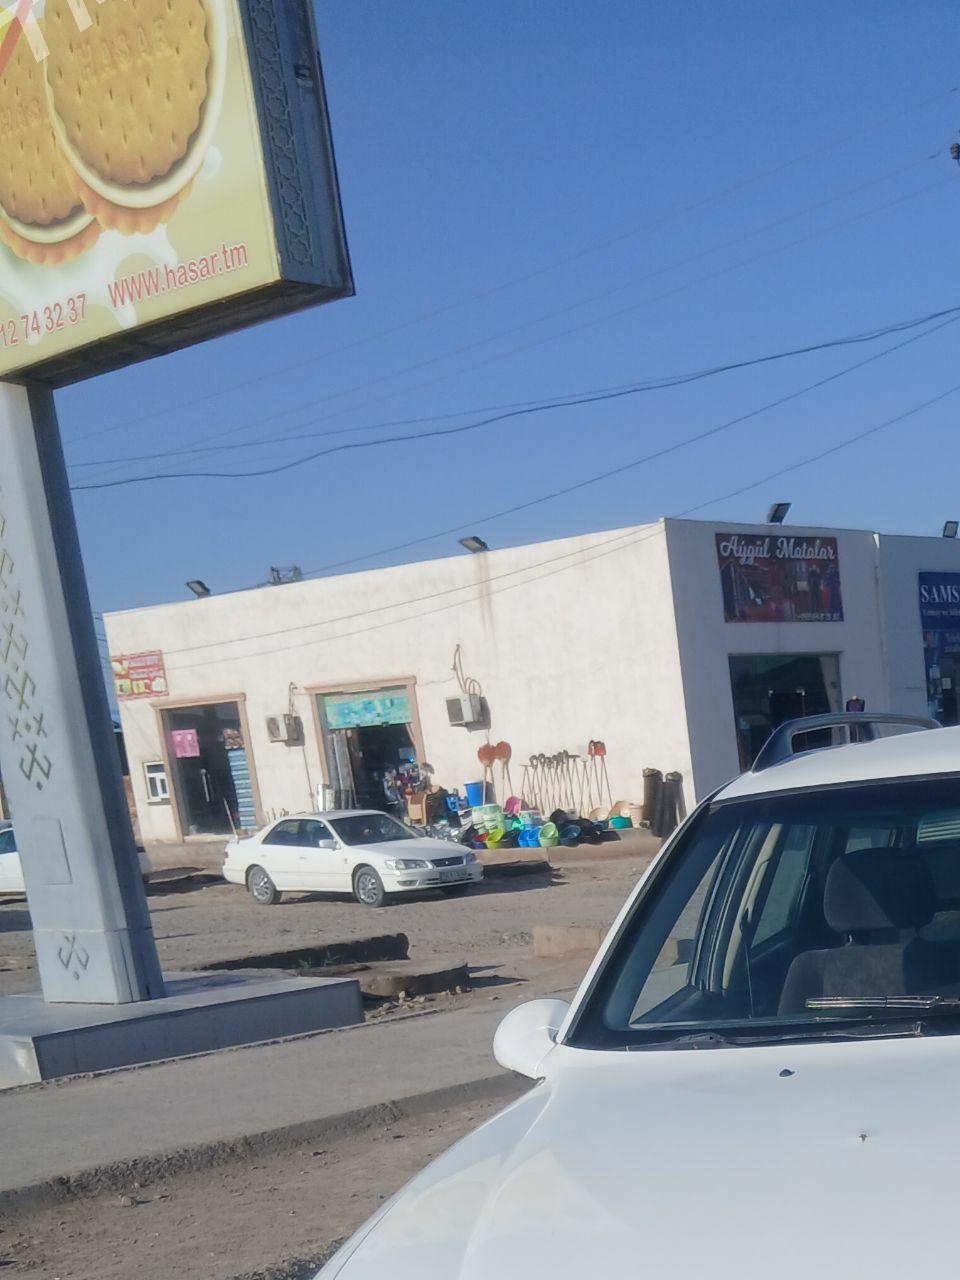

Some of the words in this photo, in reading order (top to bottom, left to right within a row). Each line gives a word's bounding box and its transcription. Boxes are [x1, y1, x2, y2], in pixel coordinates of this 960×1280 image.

[21, 311, 41, 339] 74
[44, 303, 64, 332] 32
[67, 294, 87, 323] 37
